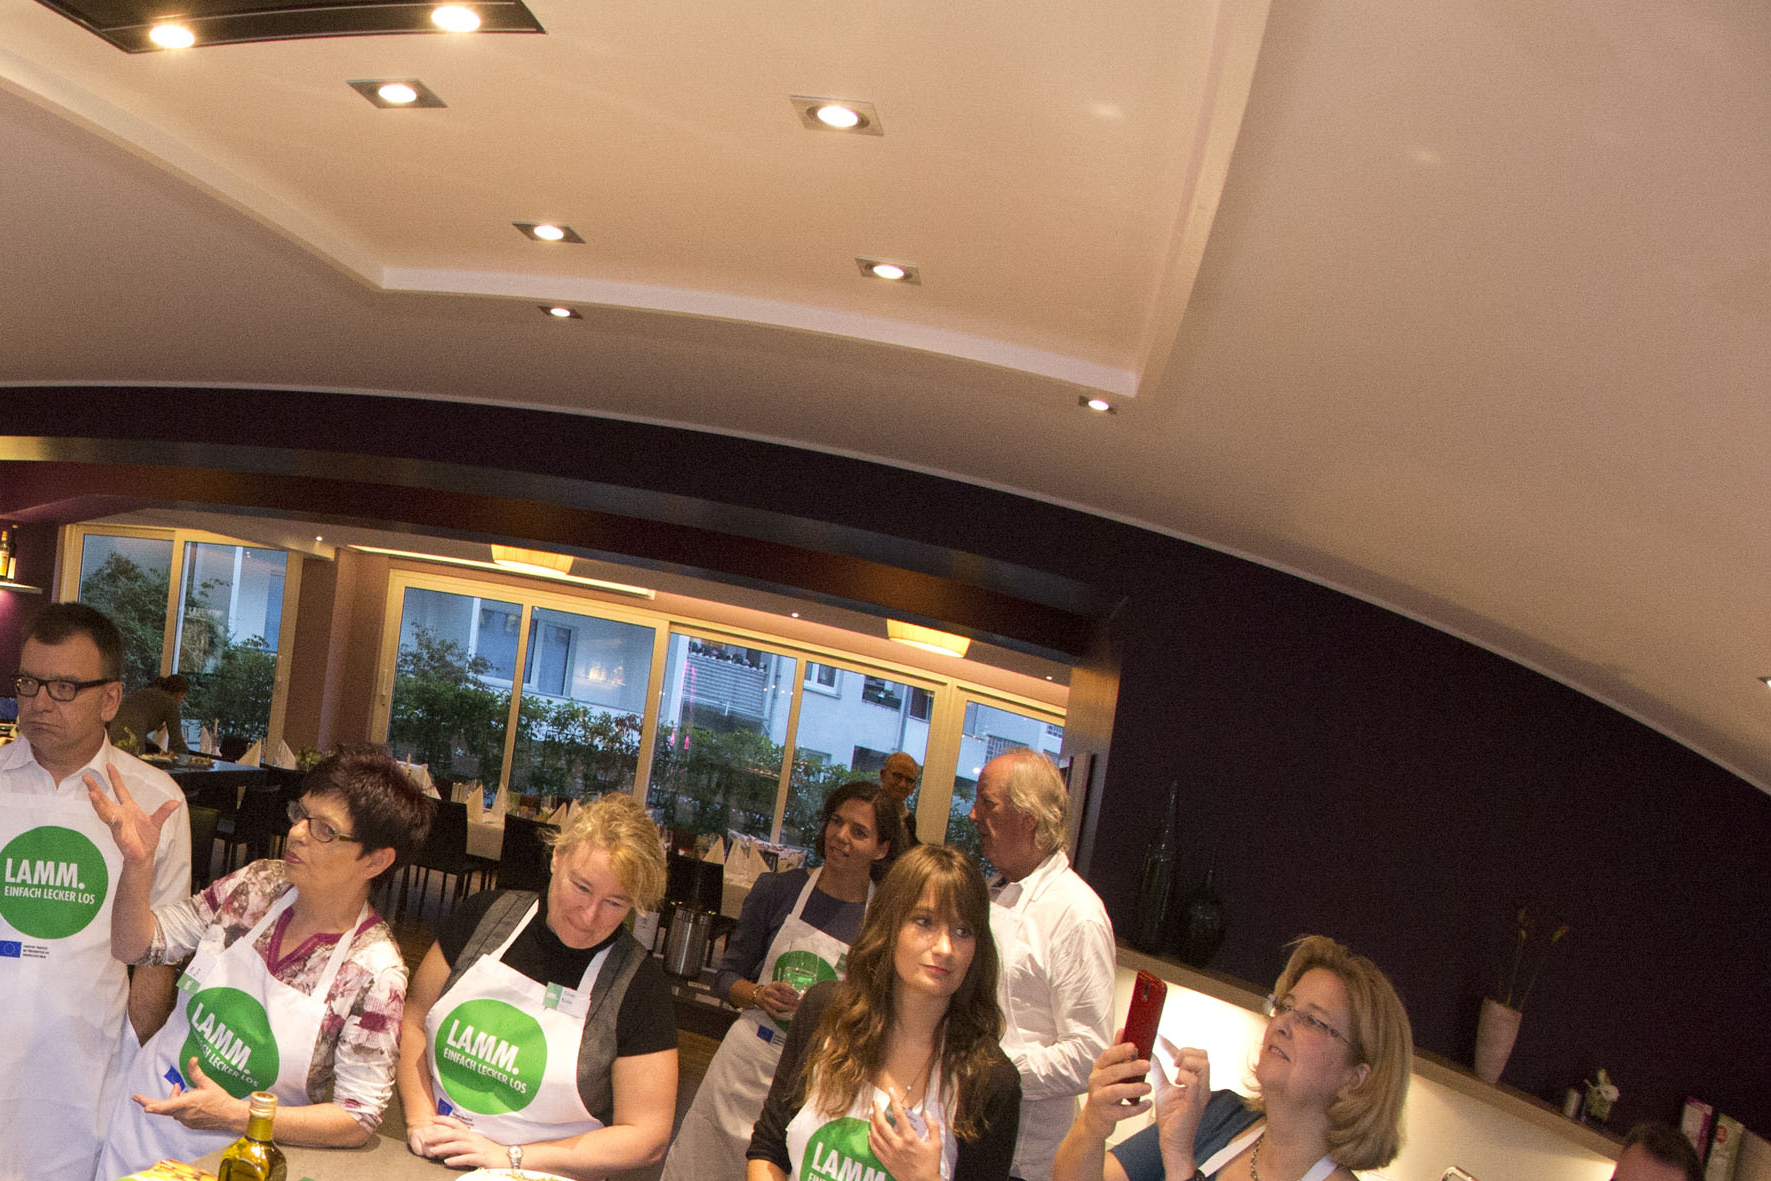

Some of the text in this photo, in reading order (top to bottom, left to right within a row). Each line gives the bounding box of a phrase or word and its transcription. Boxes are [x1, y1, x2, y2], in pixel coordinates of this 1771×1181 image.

[4, 857, 85, 890] LAMM.
[4, 886, 95, 904] EINFACH LECKER LOS
[191, 1002, 252, 1074] LAMM.
[446, 1018, 520, 1076] LAMM.
[209, 1052, 259, 1087] LECKER LOS
[443, 1047, 528, 1094] EINFACH LECKER LOS
